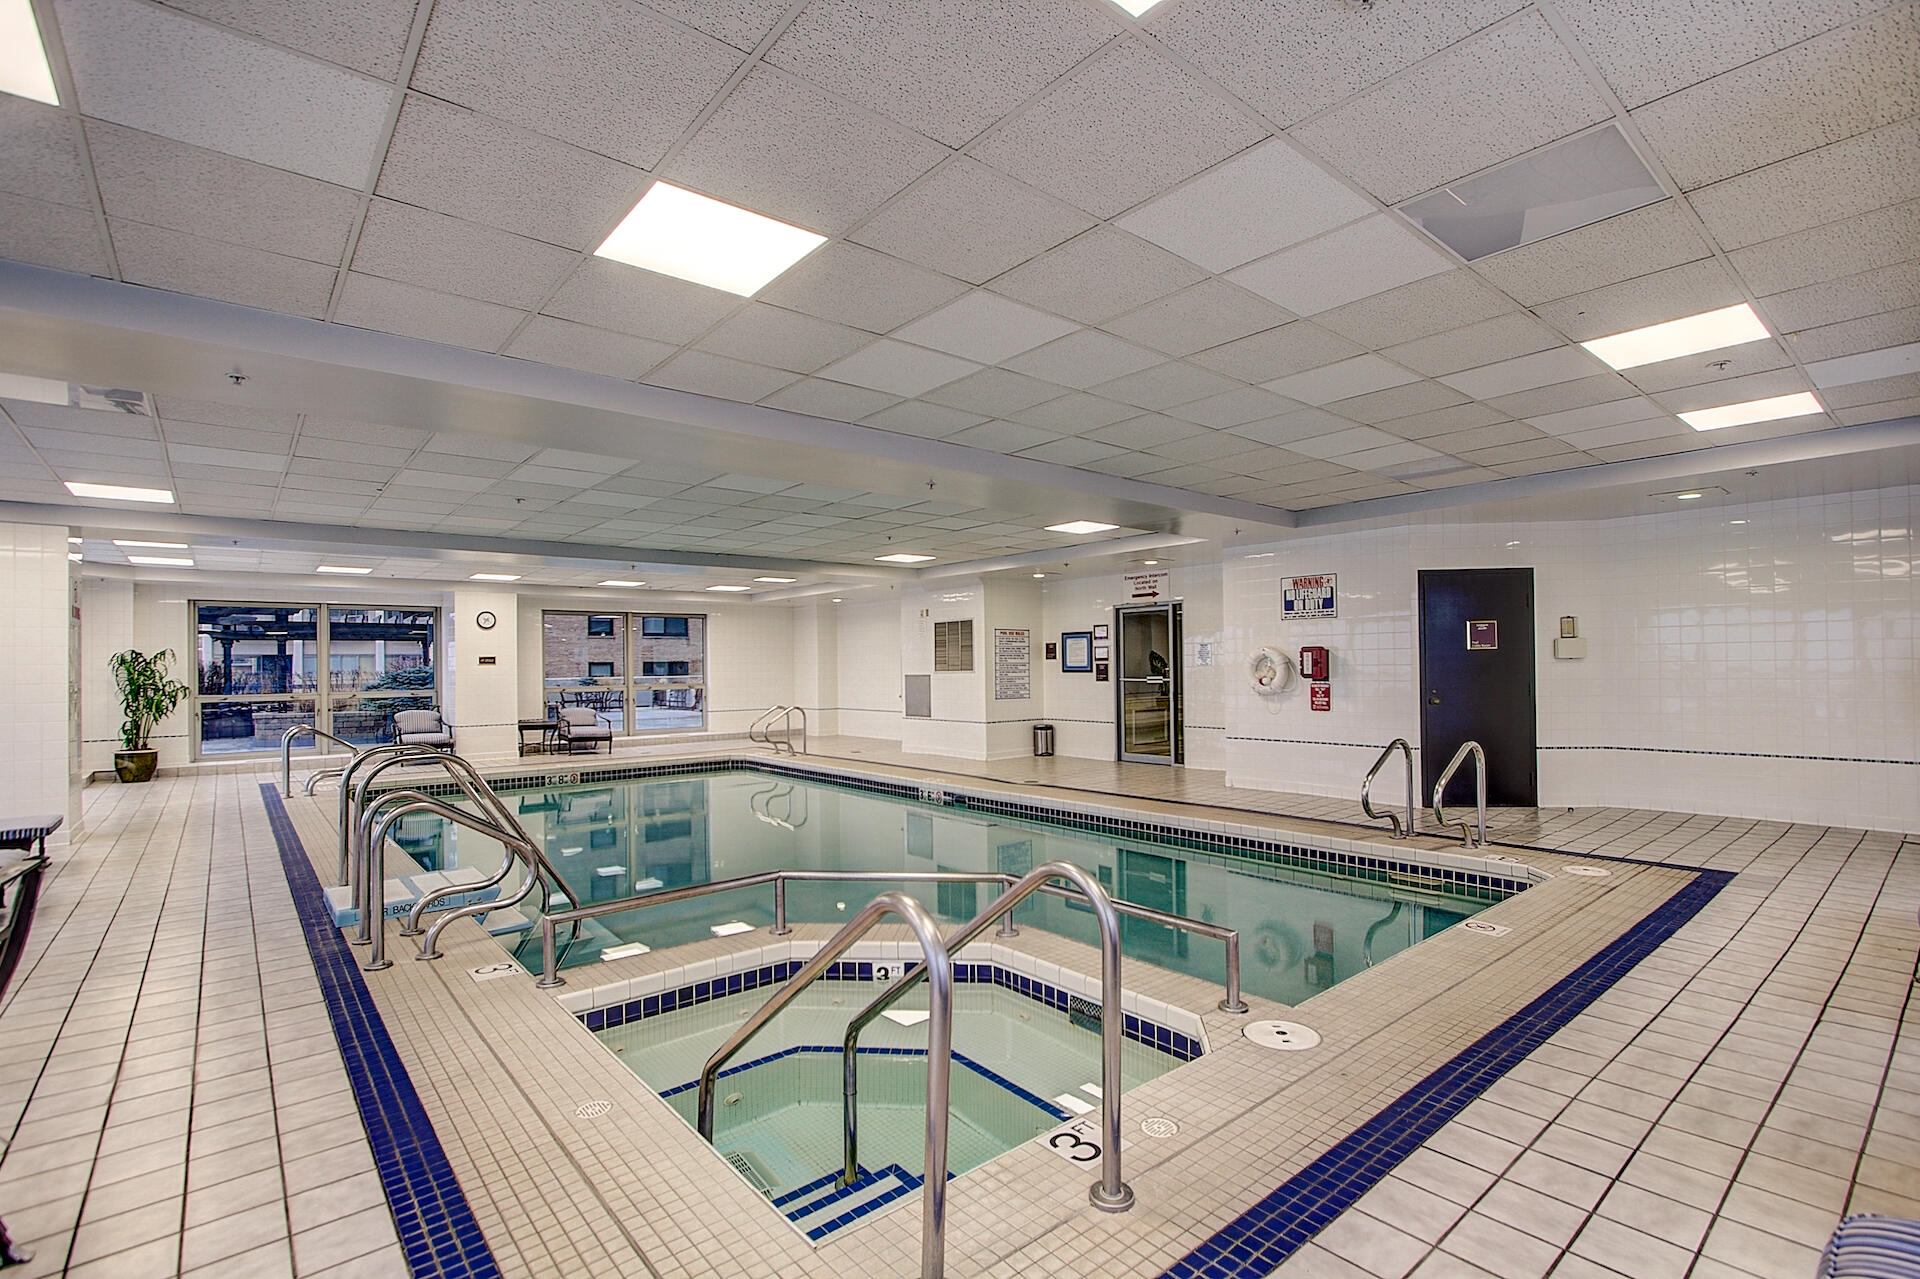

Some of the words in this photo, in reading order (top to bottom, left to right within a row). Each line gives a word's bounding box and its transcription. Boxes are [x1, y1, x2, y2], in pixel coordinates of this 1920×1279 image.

[1292, 576, 1324, 589] WARNING
[1285, 590, 1296, 601] NO
[1296, 587, 1332, 600] LIFEGUARD
[1293, 600, 1304, 611] ON
[1304, 598, 1324, 610] DUTY
[392, 897, 446, 915] BACKRDS
[474, 963, 513, 975] 3
[876, 966, 889, 981] 3
[891, 966, 901, 975] FT
[1071, 1120, 1095, 1135] FT
[1049, 1132, 1102, 1162] 3
